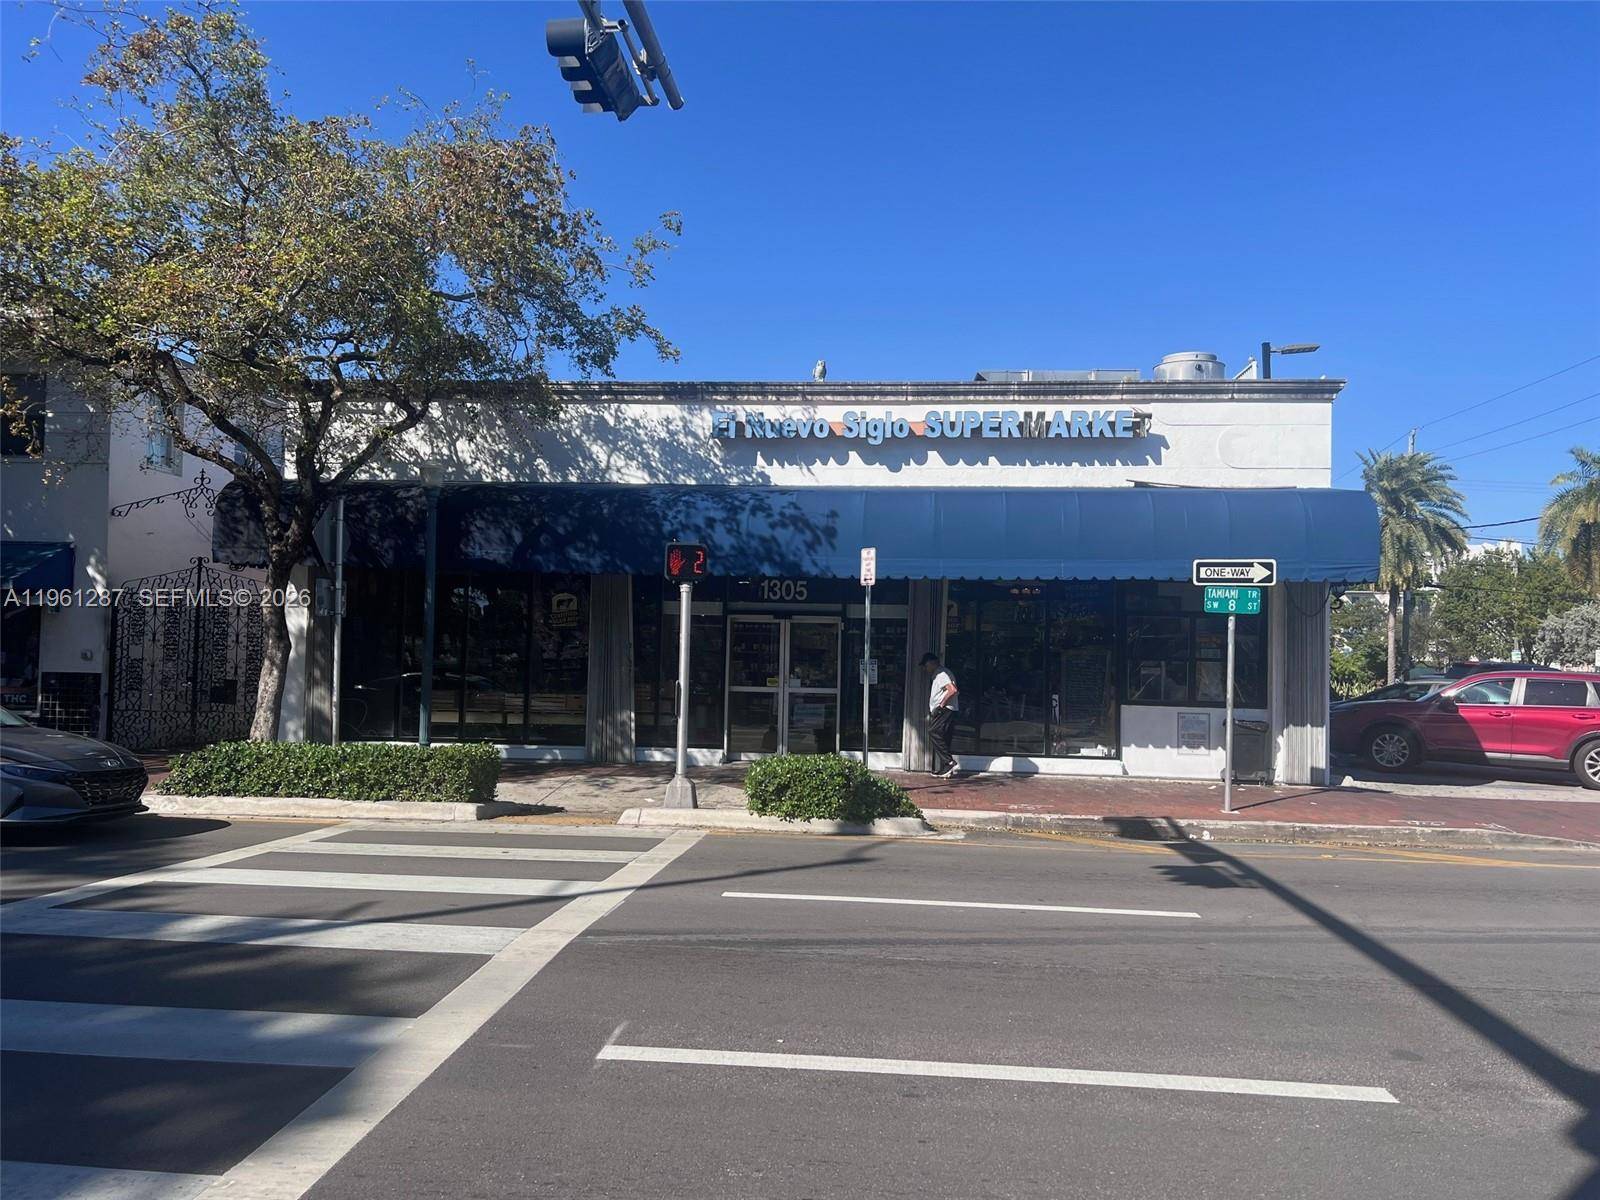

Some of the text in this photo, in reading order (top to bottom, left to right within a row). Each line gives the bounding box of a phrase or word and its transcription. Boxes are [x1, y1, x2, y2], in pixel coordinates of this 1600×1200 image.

[745, 411, 830, 439] Nuevo
[842, 410, 910, 445] Siglo
[924, 410, 1153, 439] SUPERMARKET
[694, 551, 704, 574] 2
[760, 579, 808, 600] 1305
[1208, 589, 1239, 599] TAMIAMI
[1206, 599, 1258, 611] SW 8 ST
